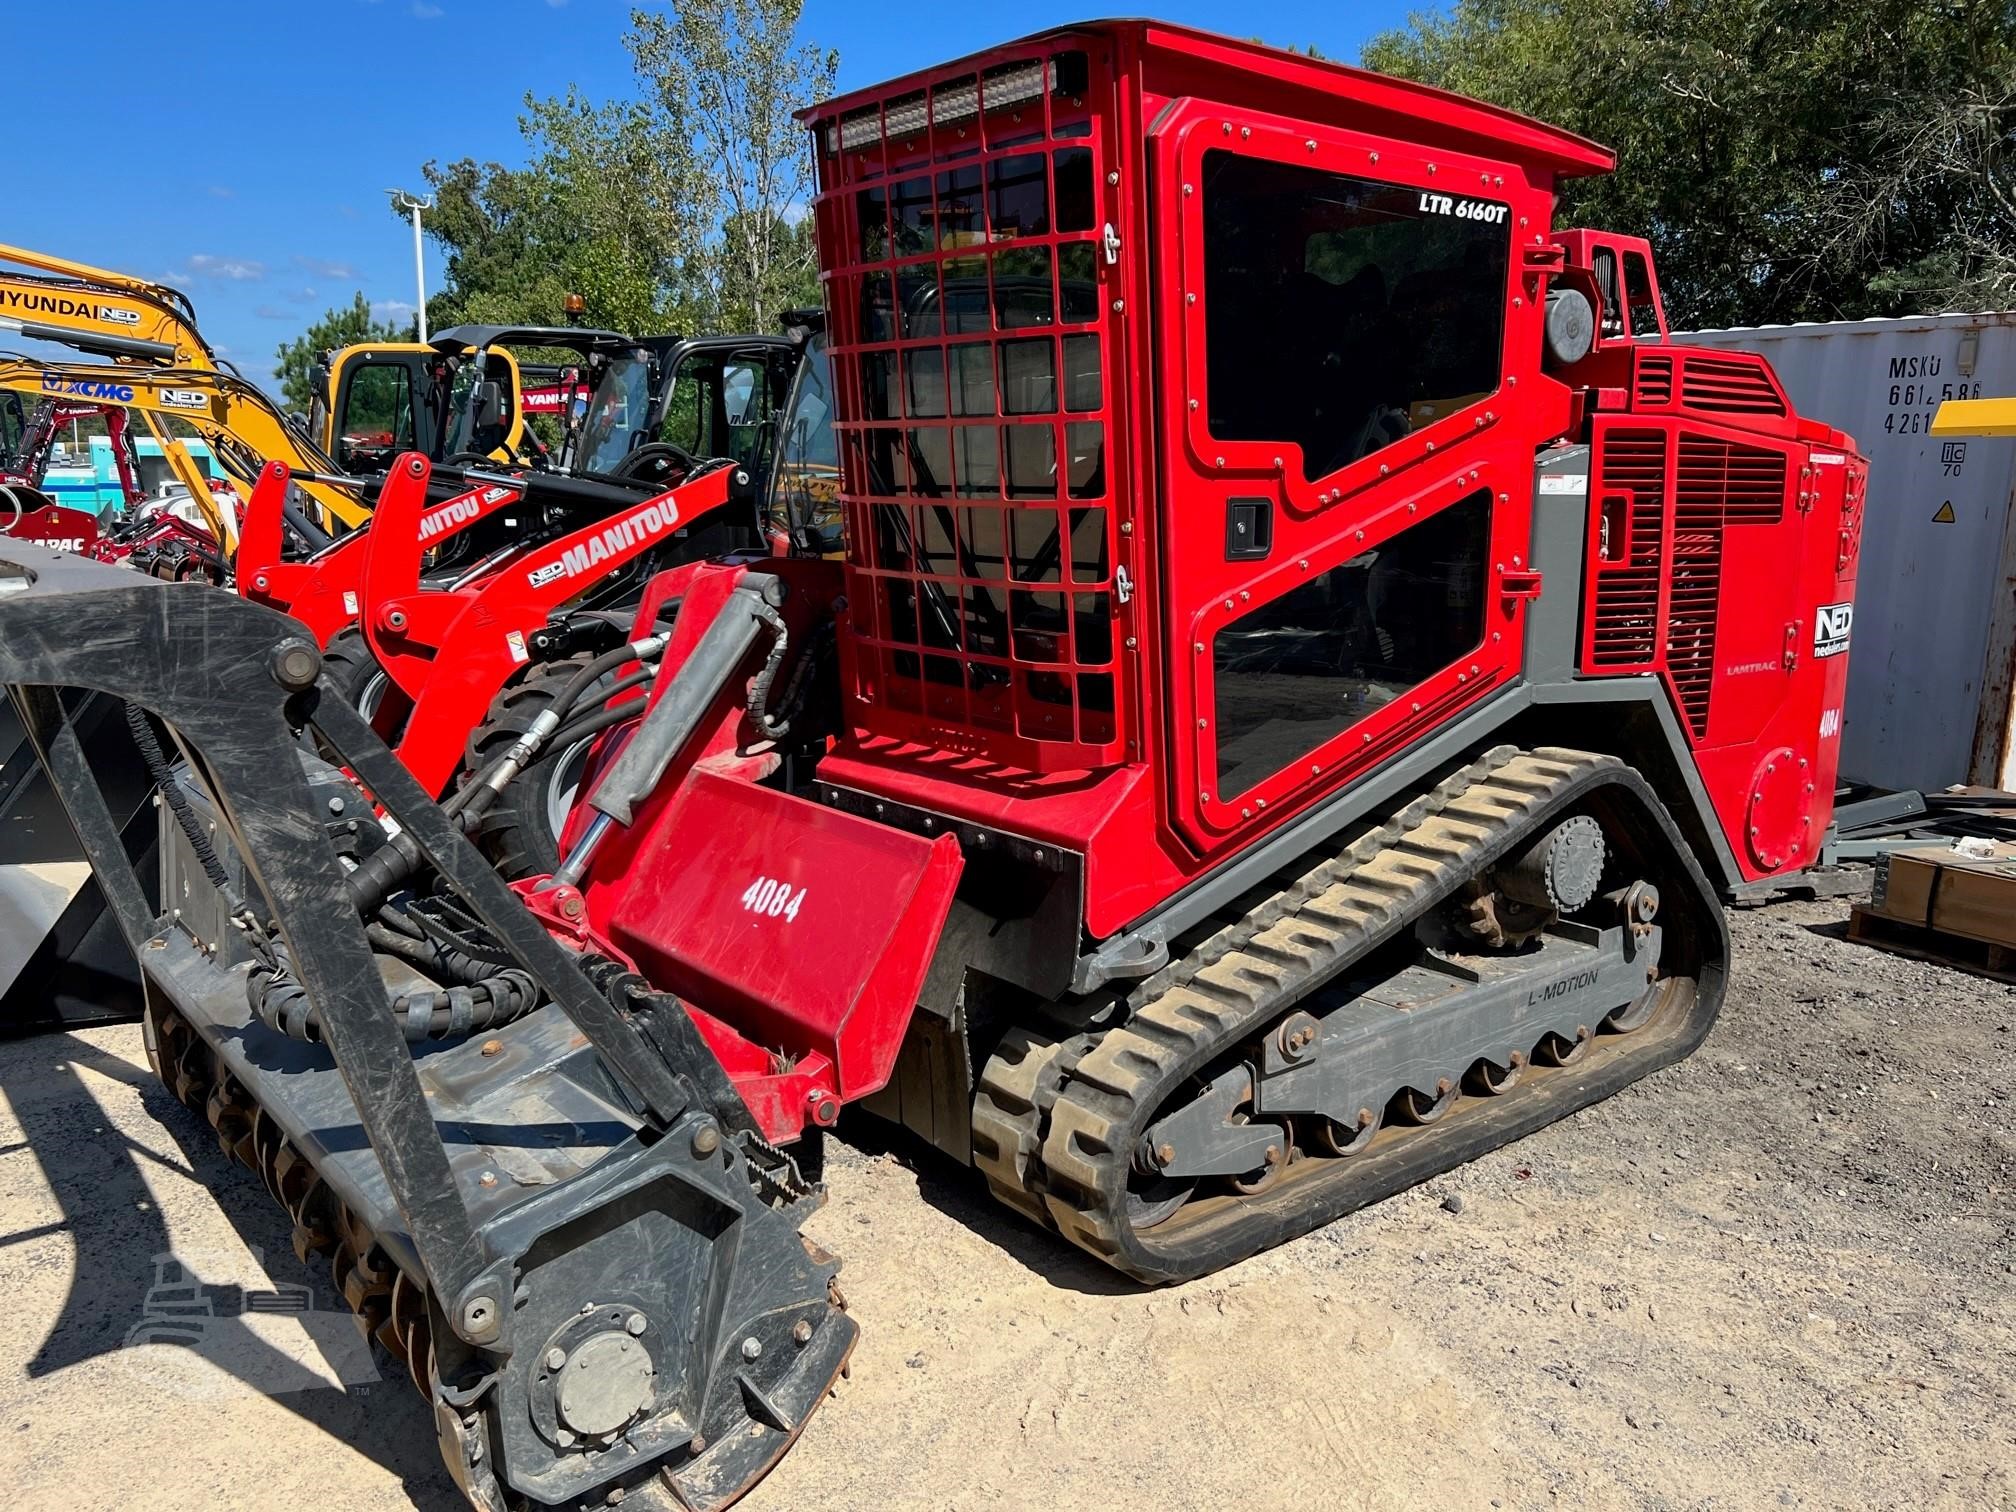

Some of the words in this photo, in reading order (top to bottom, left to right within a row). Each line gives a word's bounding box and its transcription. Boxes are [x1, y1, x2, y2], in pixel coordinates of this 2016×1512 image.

[1419, 193, 1453, 215] LTR
[1455, 200, 1507, 224] 6160T
[101, 308, 140, 321] NED
[1889, 355, 1941, 378] MSKU
[64, 382, 134, 402] XCMG
[160, 389, 208, 405] NED
[1943, 464, 1961, 477] 70
[417, 495, 480, 541] NITOU
[562, 496, 680, 578] MANITOU
[528, 561, 565, 585] NED
[1815, 605, 1852, 641] NED
[1727, 661, 1776, 676] LAMTRAC
[1819, 708, 1840, 738] 4084
[742, 876, 807, 923] 4084
[1528, 969, 1599, 1006] L-MOTION
